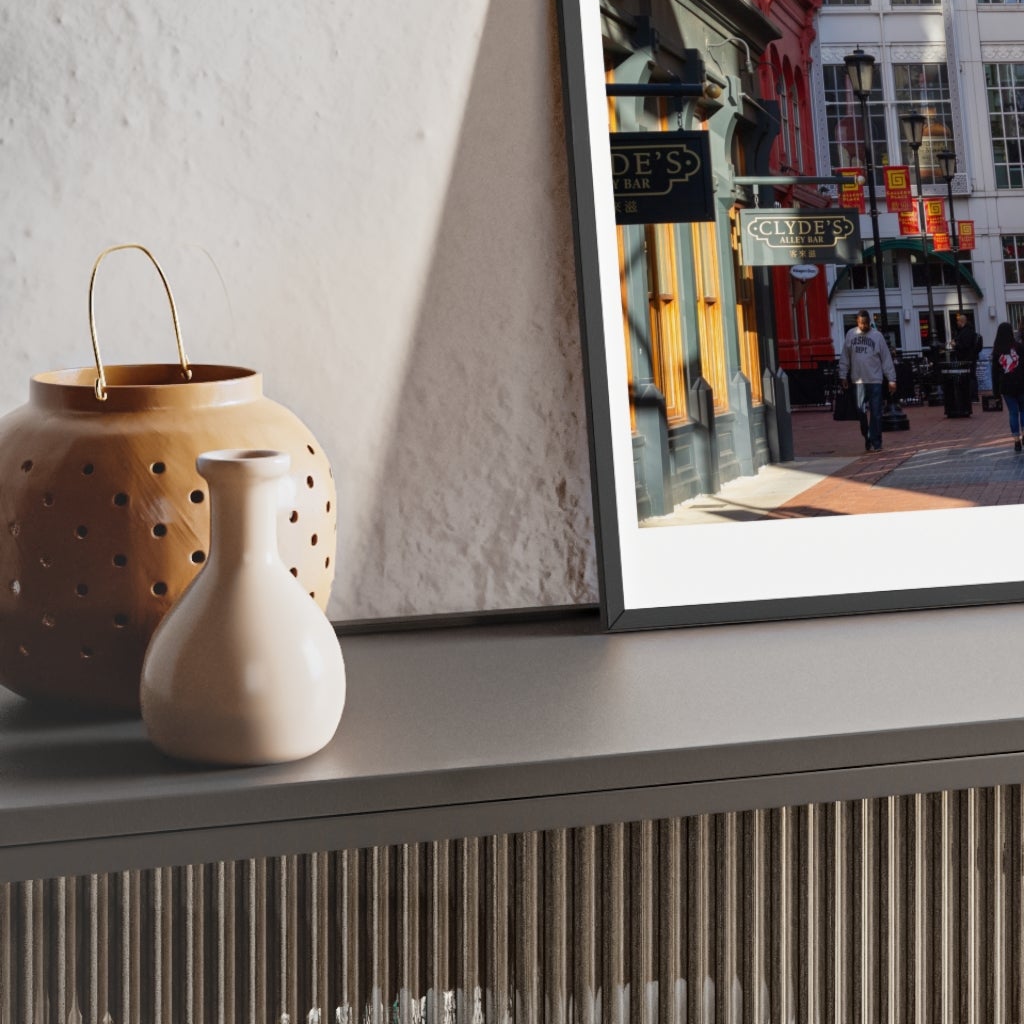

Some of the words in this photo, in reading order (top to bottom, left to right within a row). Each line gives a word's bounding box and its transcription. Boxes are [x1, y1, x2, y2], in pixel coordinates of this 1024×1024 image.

[624, 178, 651, 189] BAR
[759, 219, 843, 236] CLYDE'S
[780, 236, 805, 244] ALLEY
[807, 236, 824, 244] BAR
